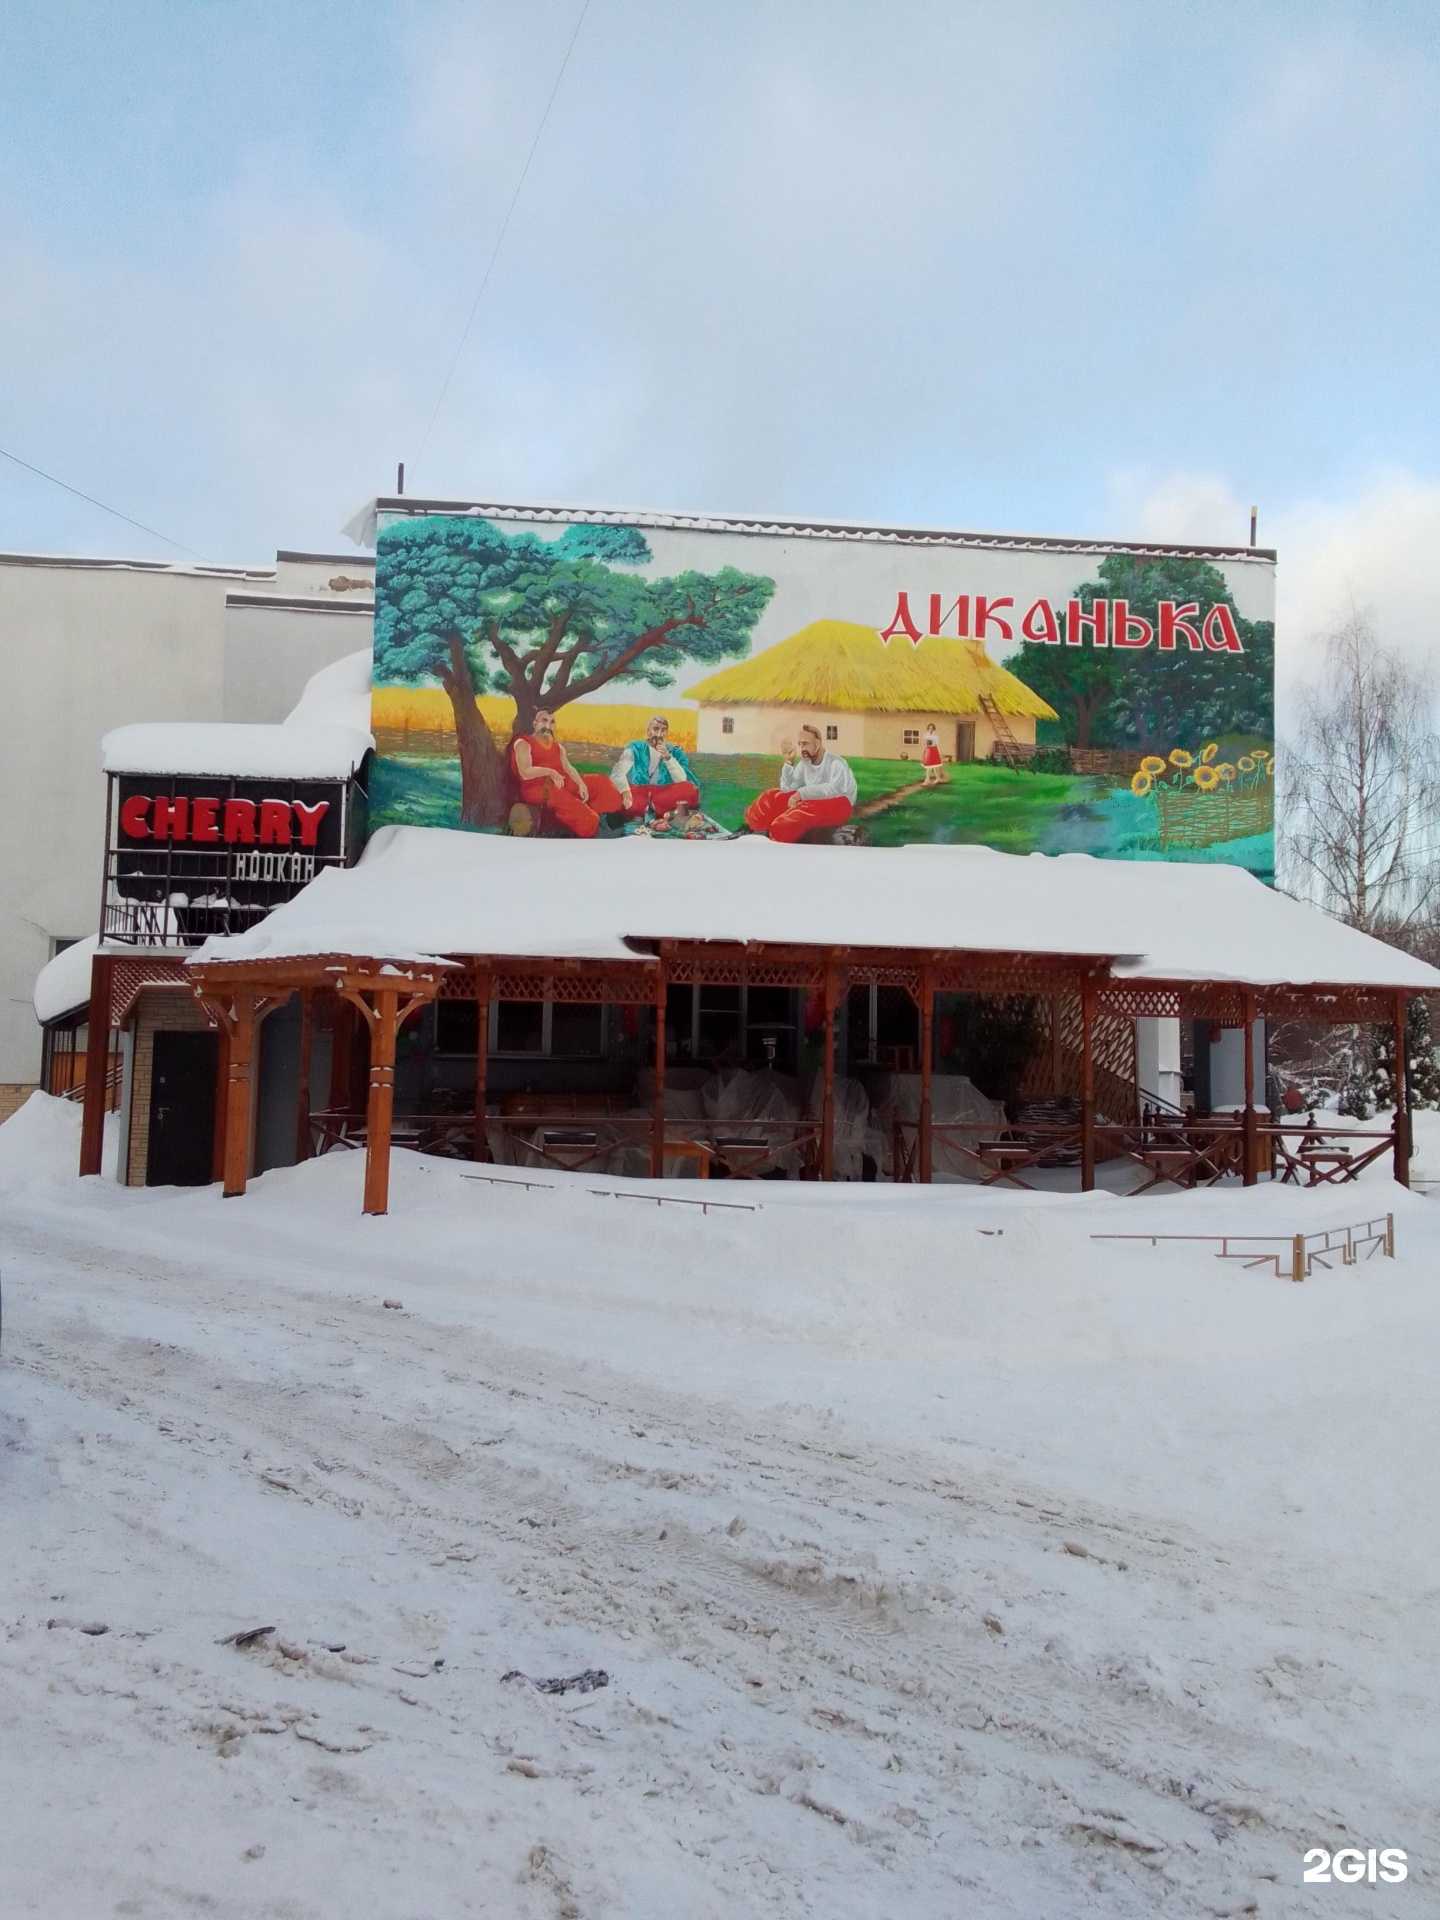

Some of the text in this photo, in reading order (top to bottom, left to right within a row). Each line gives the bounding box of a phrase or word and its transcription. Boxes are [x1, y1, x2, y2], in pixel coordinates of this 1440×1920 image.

[880, 591, 1244, 653] ДИКАНЬКА
[121, 795, 330, 846] CHERRY
[235, 851, 315, 883] HOOKAH
